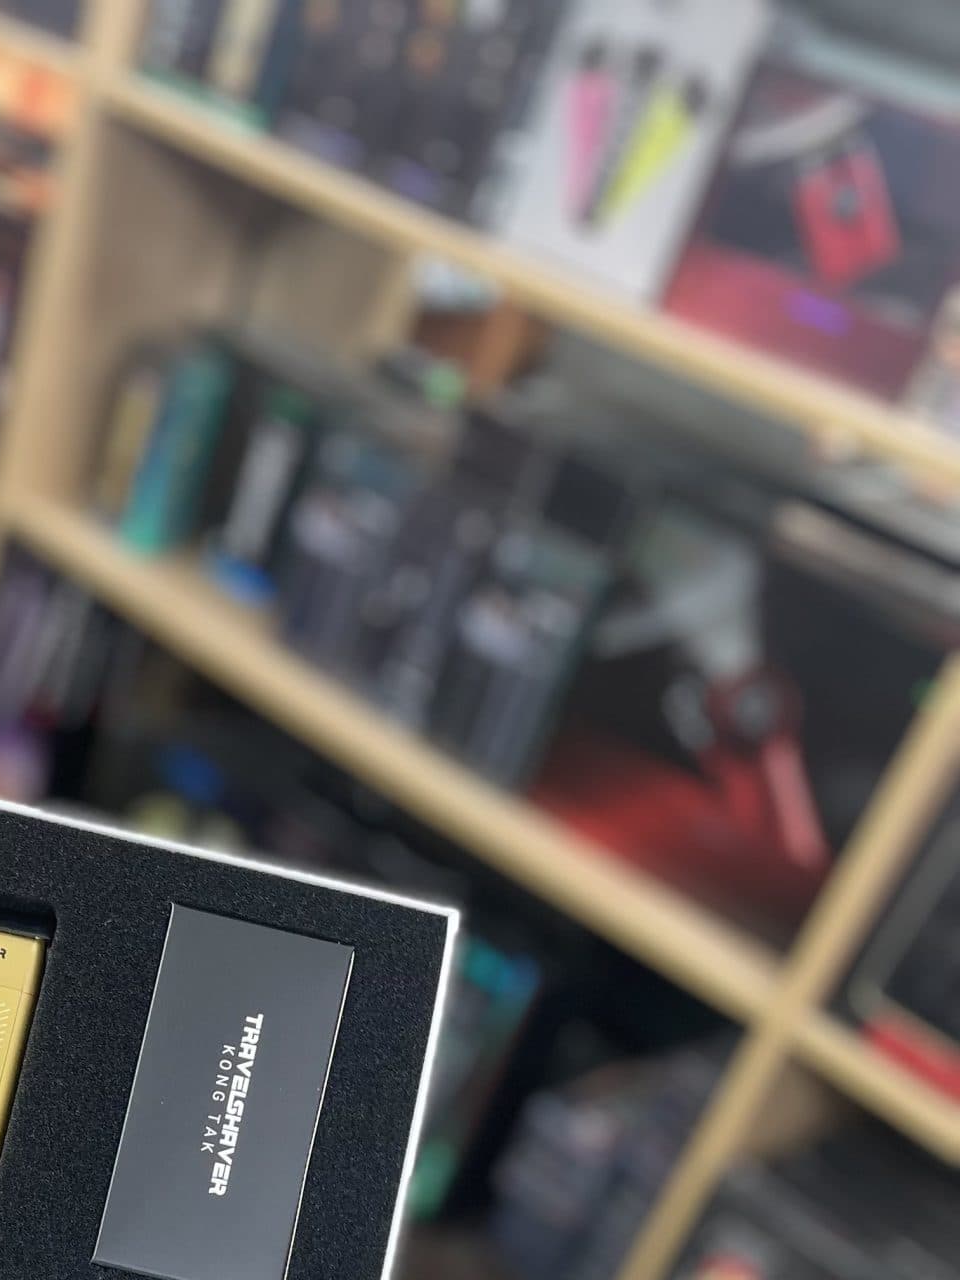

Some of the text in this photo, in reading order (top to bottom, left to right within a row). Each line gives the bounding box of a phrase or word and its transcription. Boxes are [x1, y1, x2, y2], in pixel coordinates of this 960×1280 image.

[200, 1044, 236, 1153] KONG TAK
[208, 1013, 264, 1196] TRAVELSHAVER
